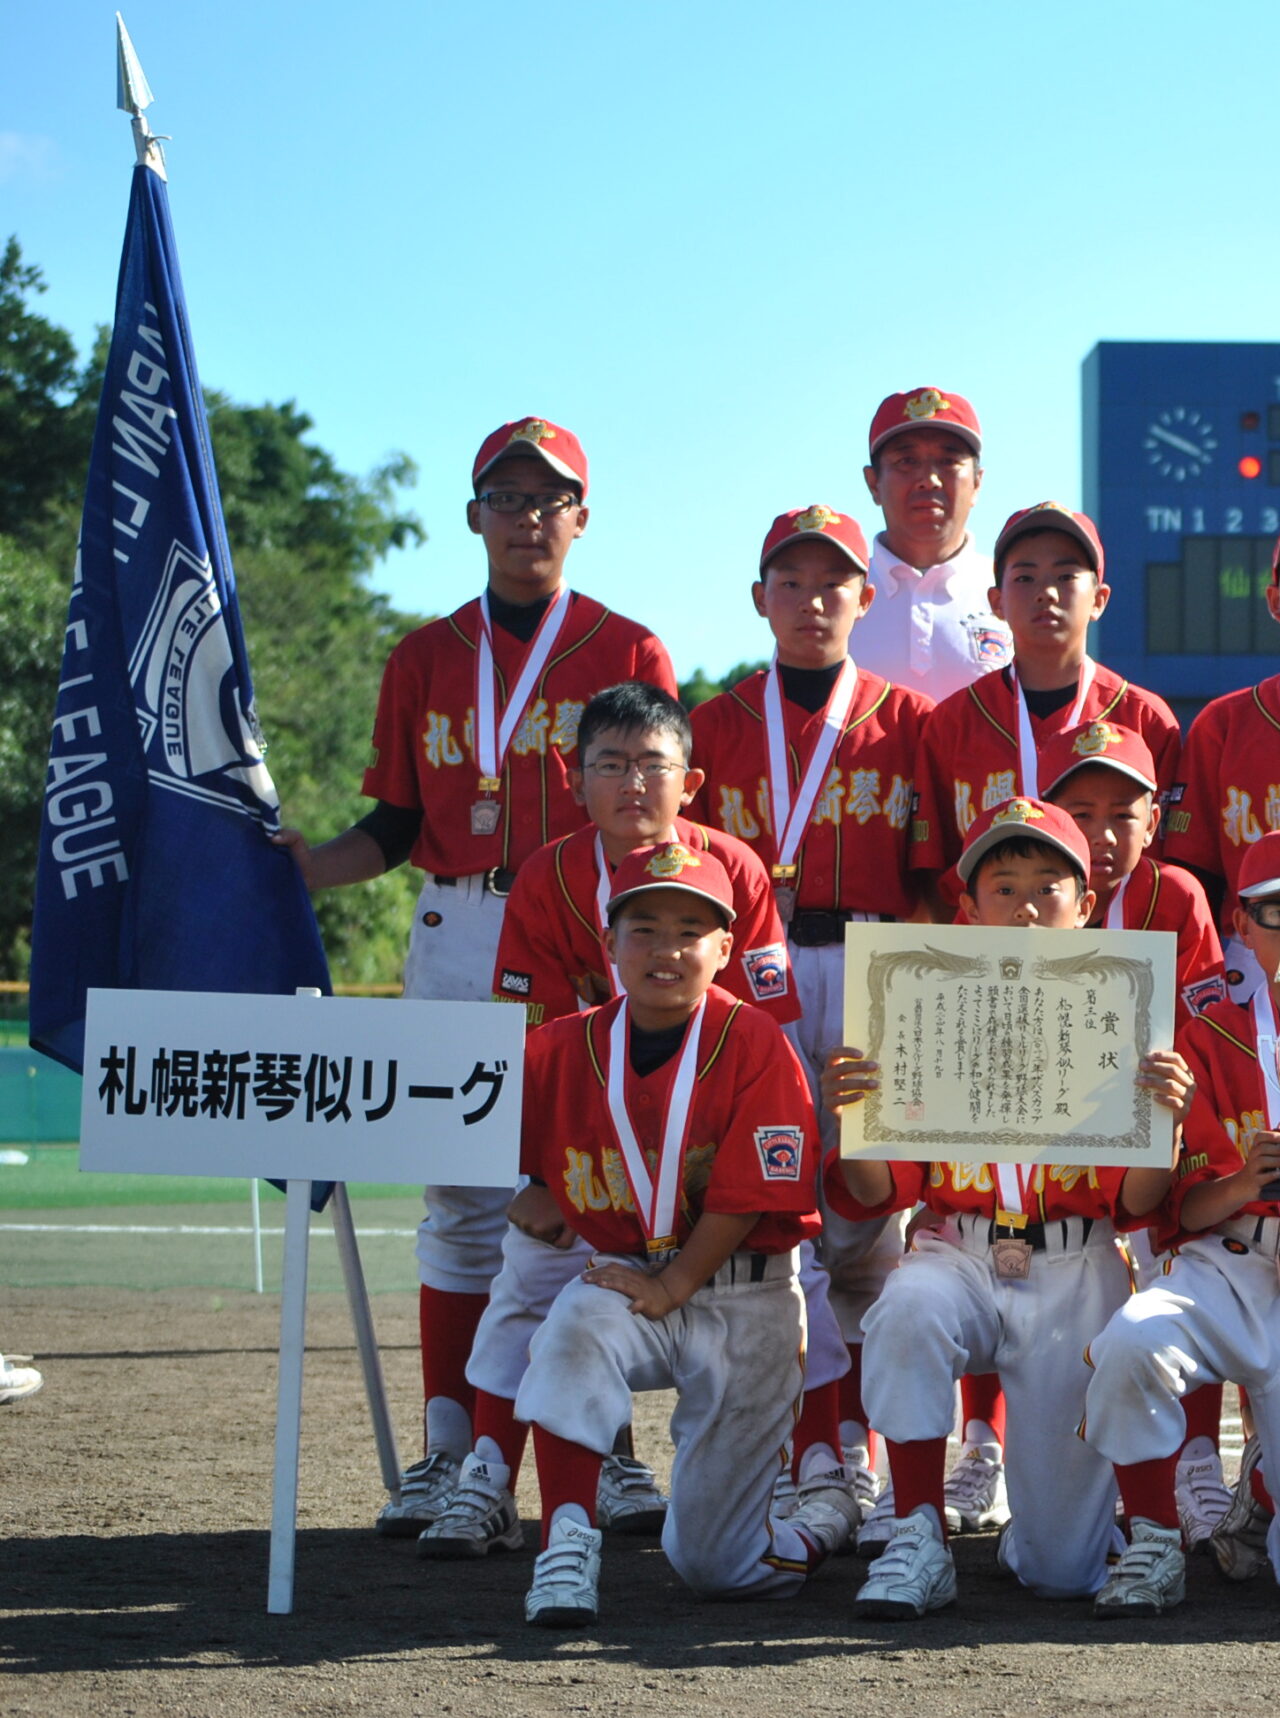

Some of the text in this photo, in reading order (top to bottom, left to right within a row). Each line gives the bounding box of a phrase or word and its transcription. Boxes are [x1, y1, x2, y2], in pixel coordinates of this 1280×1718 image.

[1148, 508, 1181, 532] TN
[1192, 508, 1205, 532] 1
[1227, 508, 1242, 533] 2
[1263, 508, 1279, 533] 3
[1083, 989, 1097, 1030] 第三位
[1098, 1010, 1119, 1070] 賞状
[98, 1045, 509, 1126] 札幌新琴似リーグ
